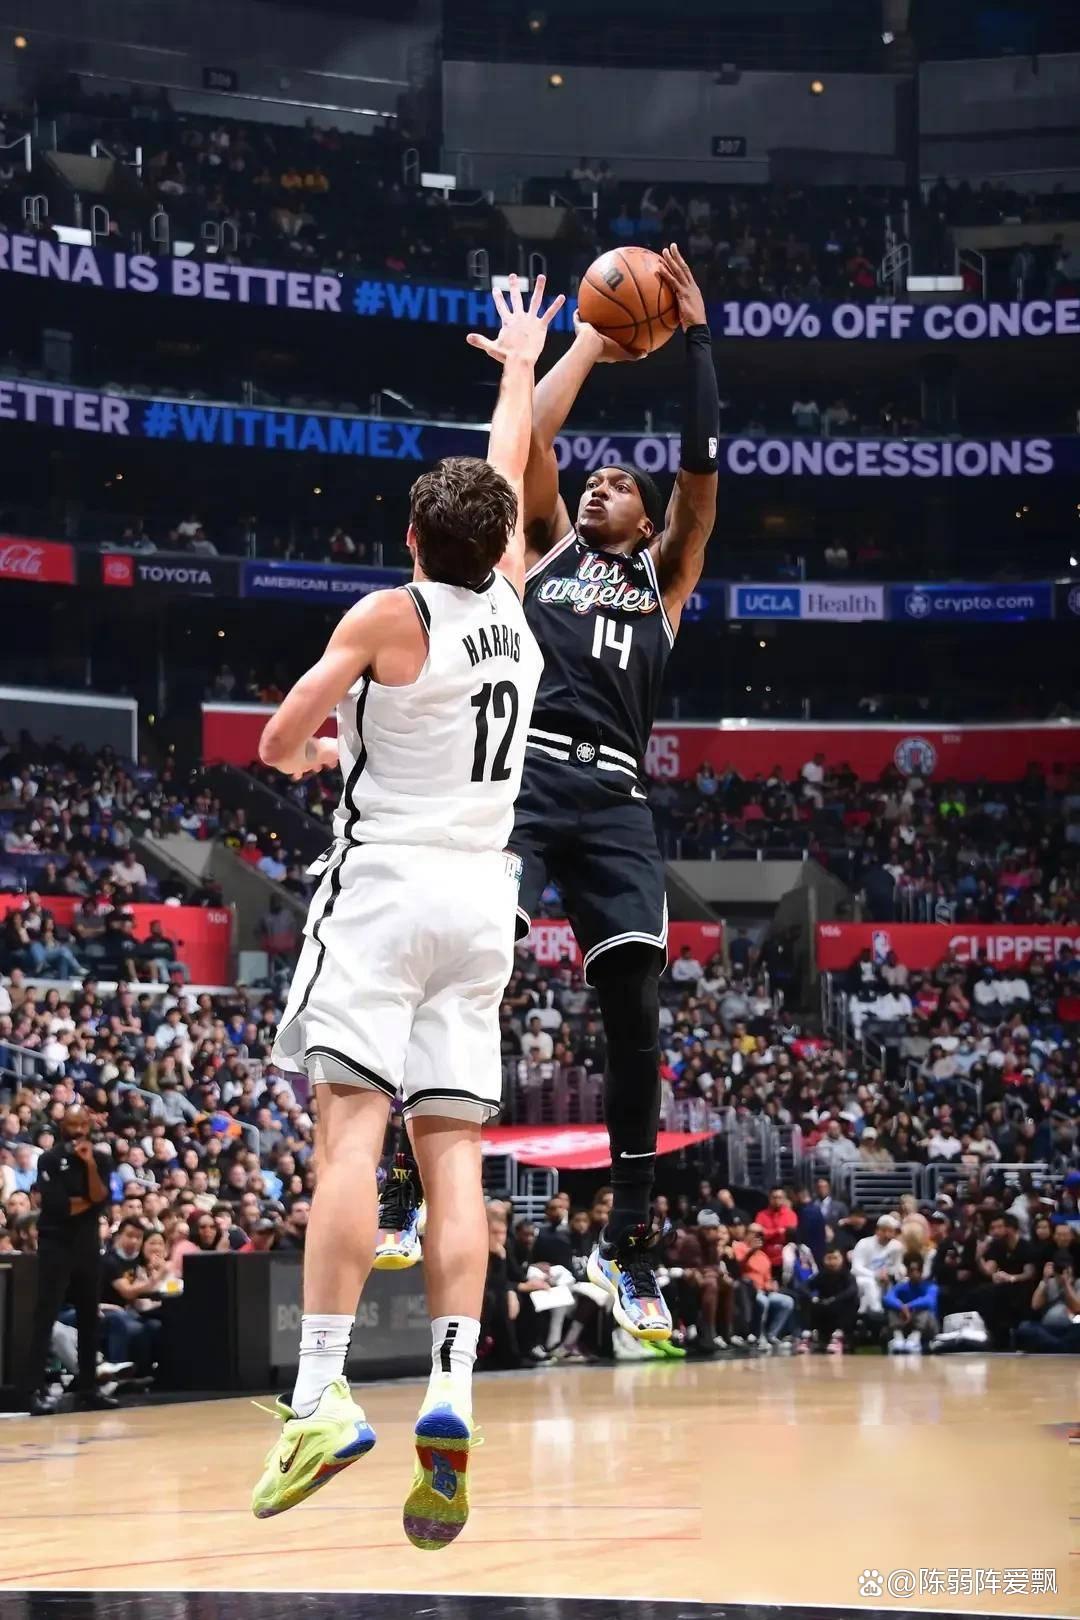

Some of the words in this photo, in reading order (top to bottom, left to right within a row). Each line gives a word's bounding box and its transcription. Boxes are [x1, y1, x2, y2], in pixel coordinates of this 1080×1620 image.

[114, 252, 159, 293] IS
[171, 259, 342, 313] BETTER
[722, 301, 821, 338] 10%
[832, 304, 914, 340] OFF
[923, 299, 1080, 340] CONCE
[143, 401, 423, 460] #WITHAMEX
[634, 437, 681, 473] OF
[727, 438, 1054, 477] CONCESSIONS
[138, 565, 212, 584] TOYOTA
[253, 576, 328, 591] AMERICAN
[745, 594, 794, 611] UCLA
[808, 594, 877, 613] Health
[934, 596, 1034, 612] crypto.com
[462, 624, 521, 667] HARRIS
[591, 614, 633, 671] 14
[470, 680, 519, 782] 12
